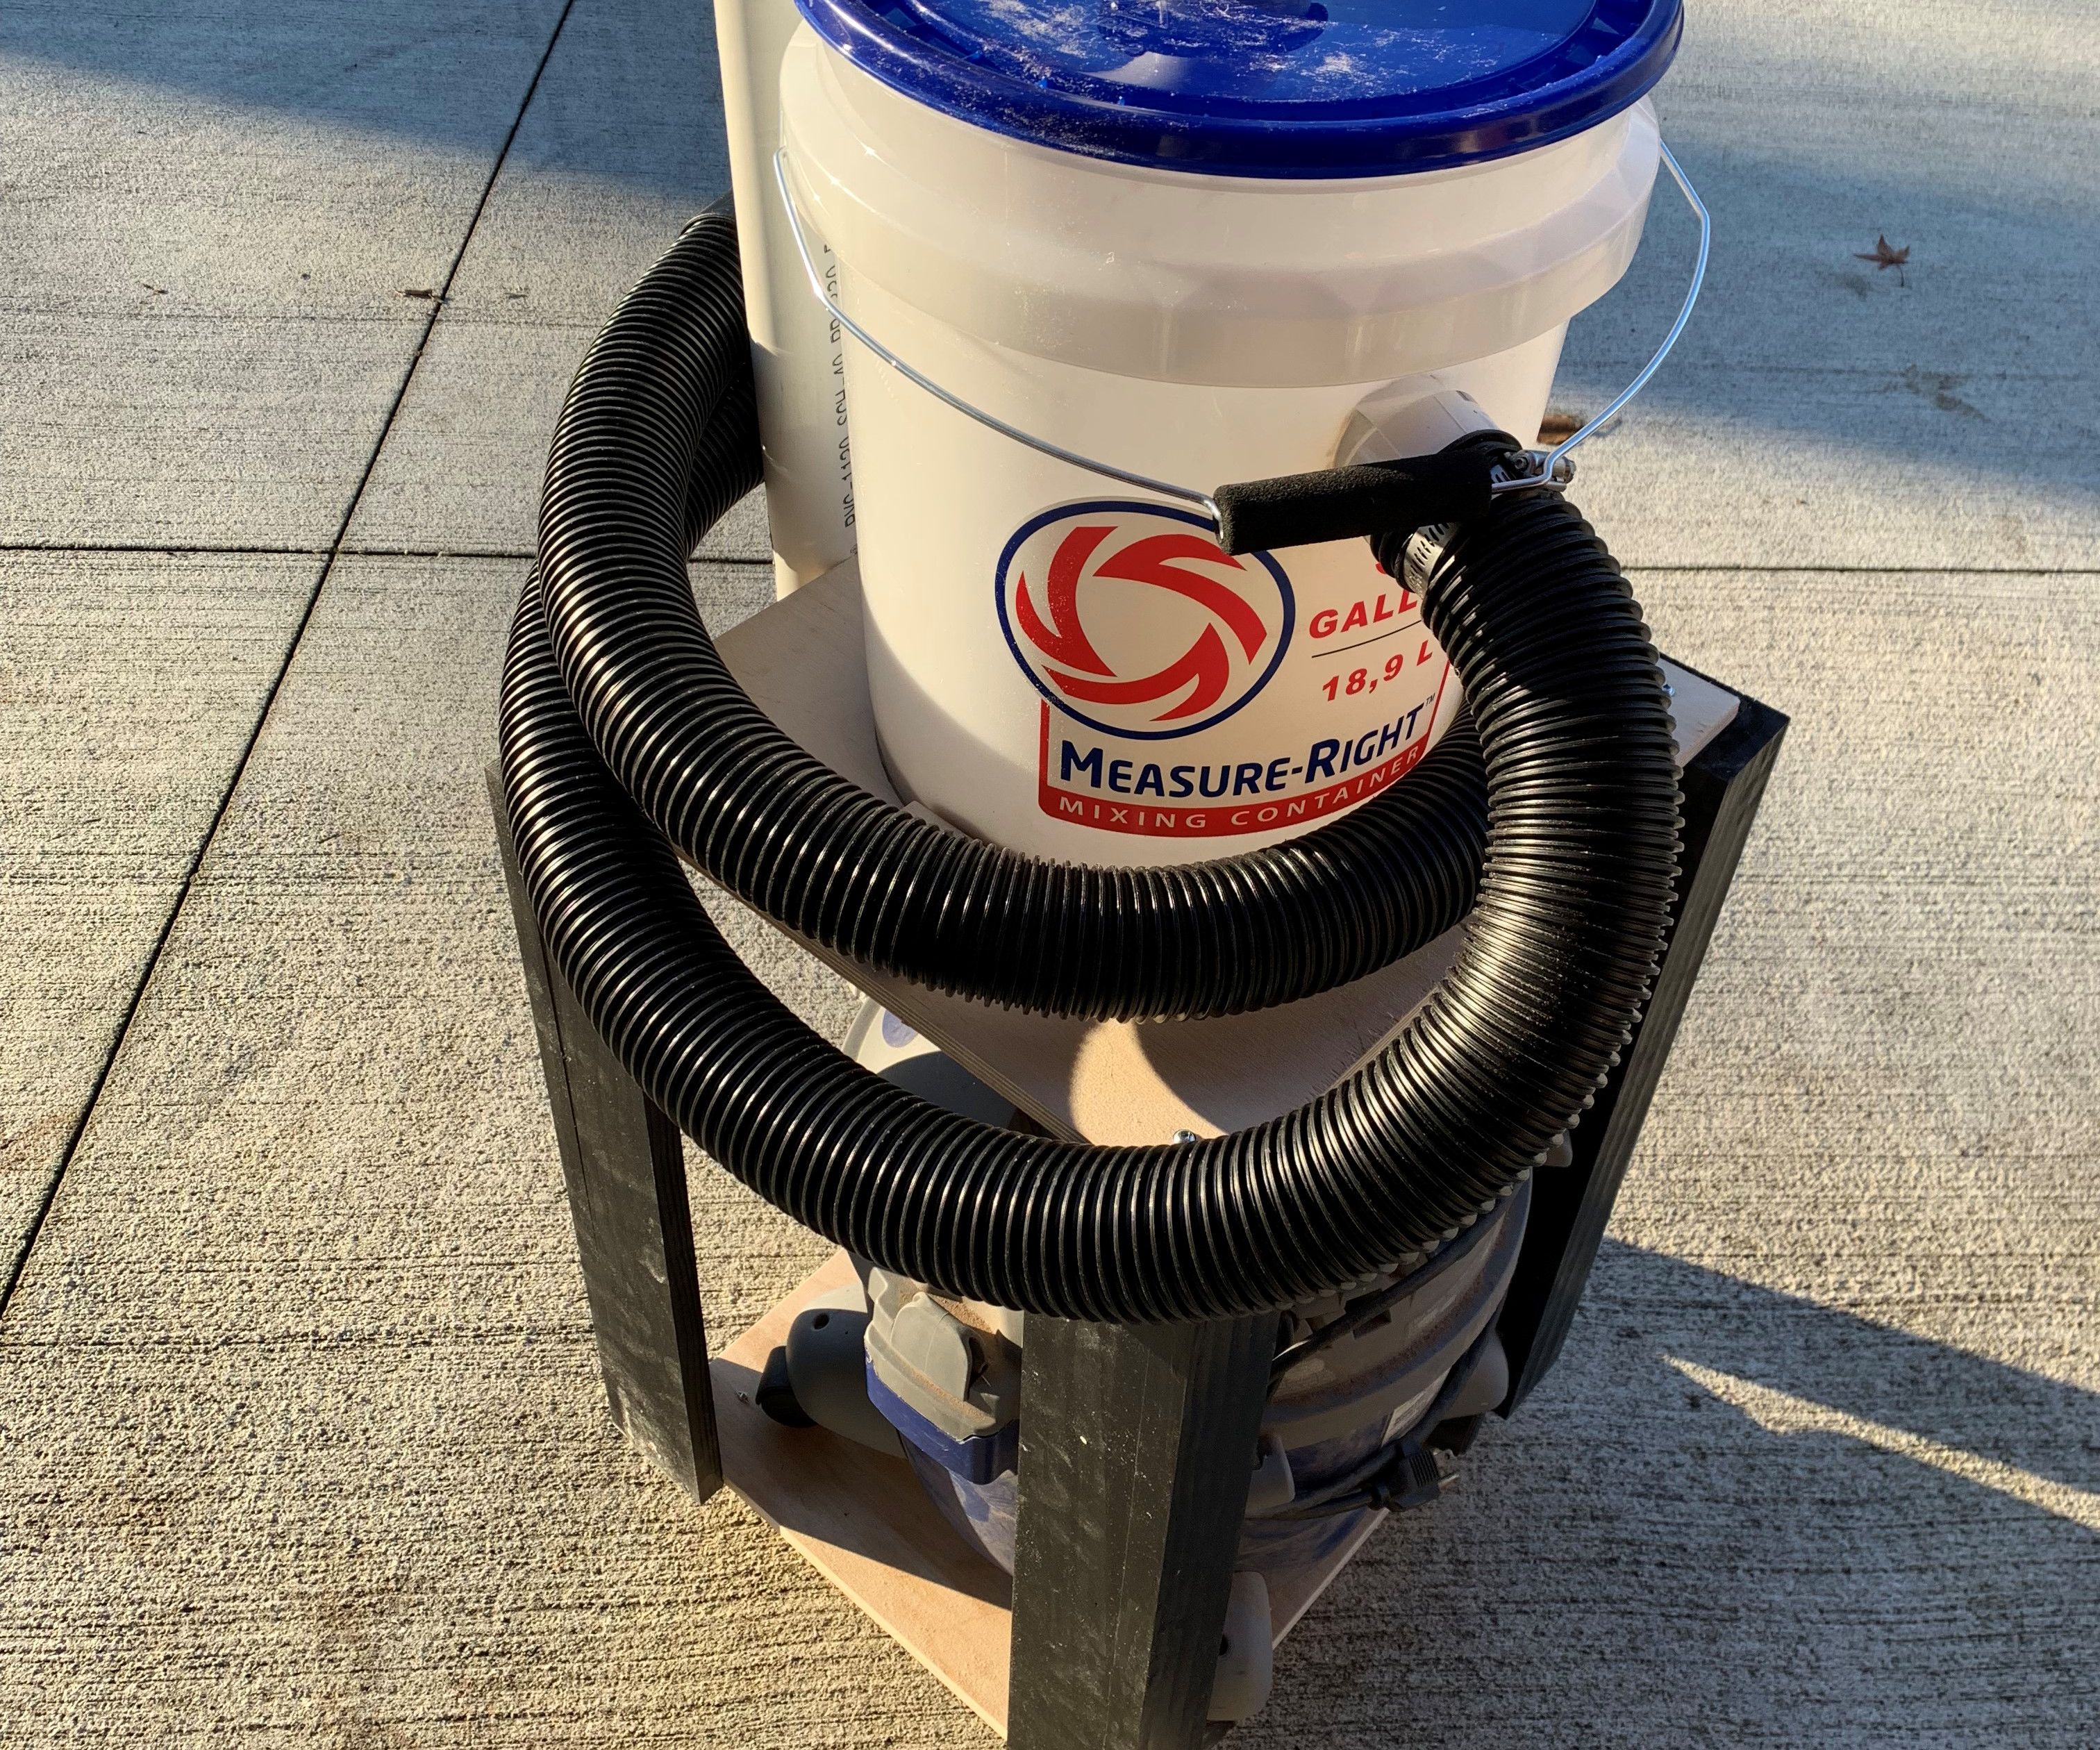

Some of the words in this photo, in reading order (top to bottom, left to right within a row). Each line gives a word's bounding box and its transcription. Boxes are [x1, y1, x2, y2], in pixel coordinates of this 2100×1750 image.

[1322, 653, 1403, 702] 18,9
[1416, 640, 1433, 667] L
[1058, 796, 1206, 828] MIXING
[1231, 745, 1419, 826] CONTAINER
